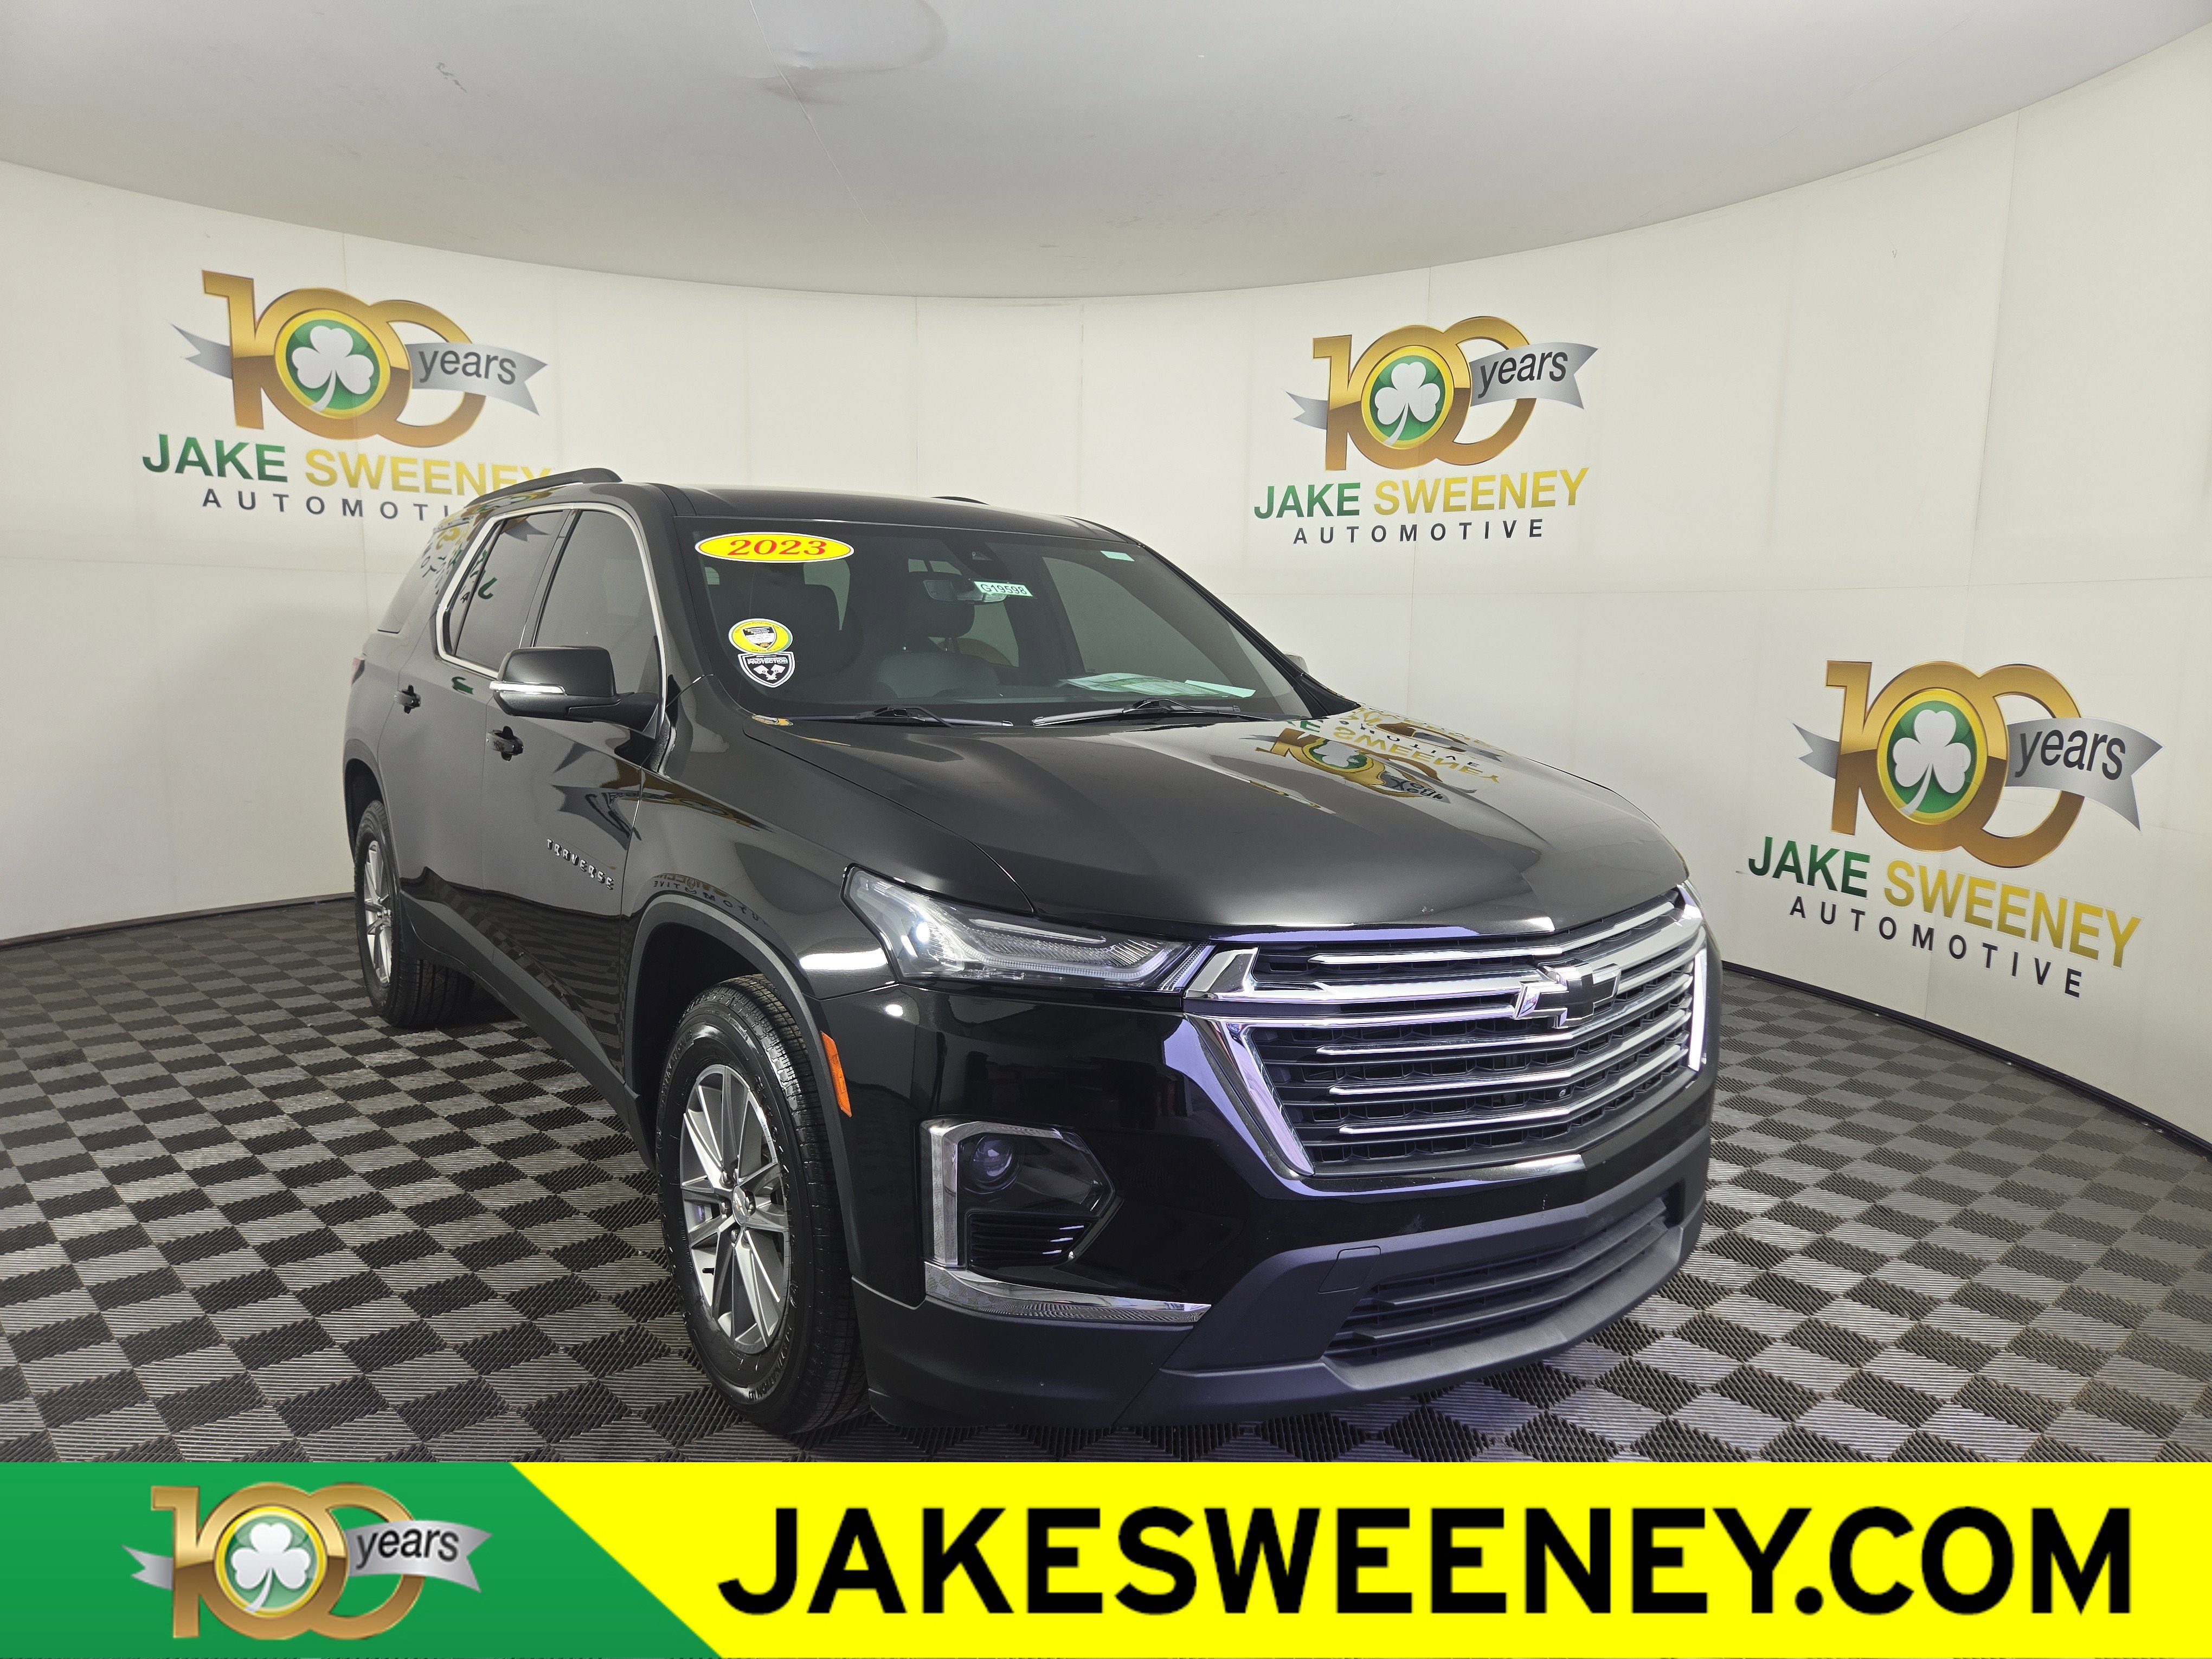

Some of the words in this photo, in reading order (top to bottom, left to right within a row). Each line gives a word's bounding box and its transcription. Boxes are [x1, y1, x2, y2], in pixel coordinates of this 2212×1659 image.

[201, 269, 487, 448] 100
[417, 349, 517, 385] years
[1313, 316, 1538, 471] 100
[1477, 350, 1568, 399] years
[142, 433, 288, 484] JAKE
[202, 487, 449, 522] AUTOMOTI
[1253, 482, 1361, 519] JAKE
[1373, 466, 1590, 516] SWEENEY
[727, 539, 827, 556] 2023
[1293, 518, 1543, 545] AUTOMOTIVE
[980, 584, 1027, 595] G19598
[1825, 660, 2086, 869] 100
[2014, 729, 2126, 781] years
[547, 839, 614, 890] TRAVERSE
[1748, 836, 1871, 899] JAKE
[1883, 859, 2142, 968] SWEENEY
[1789, 896, 2082, 998] AUTOMOTIVE
